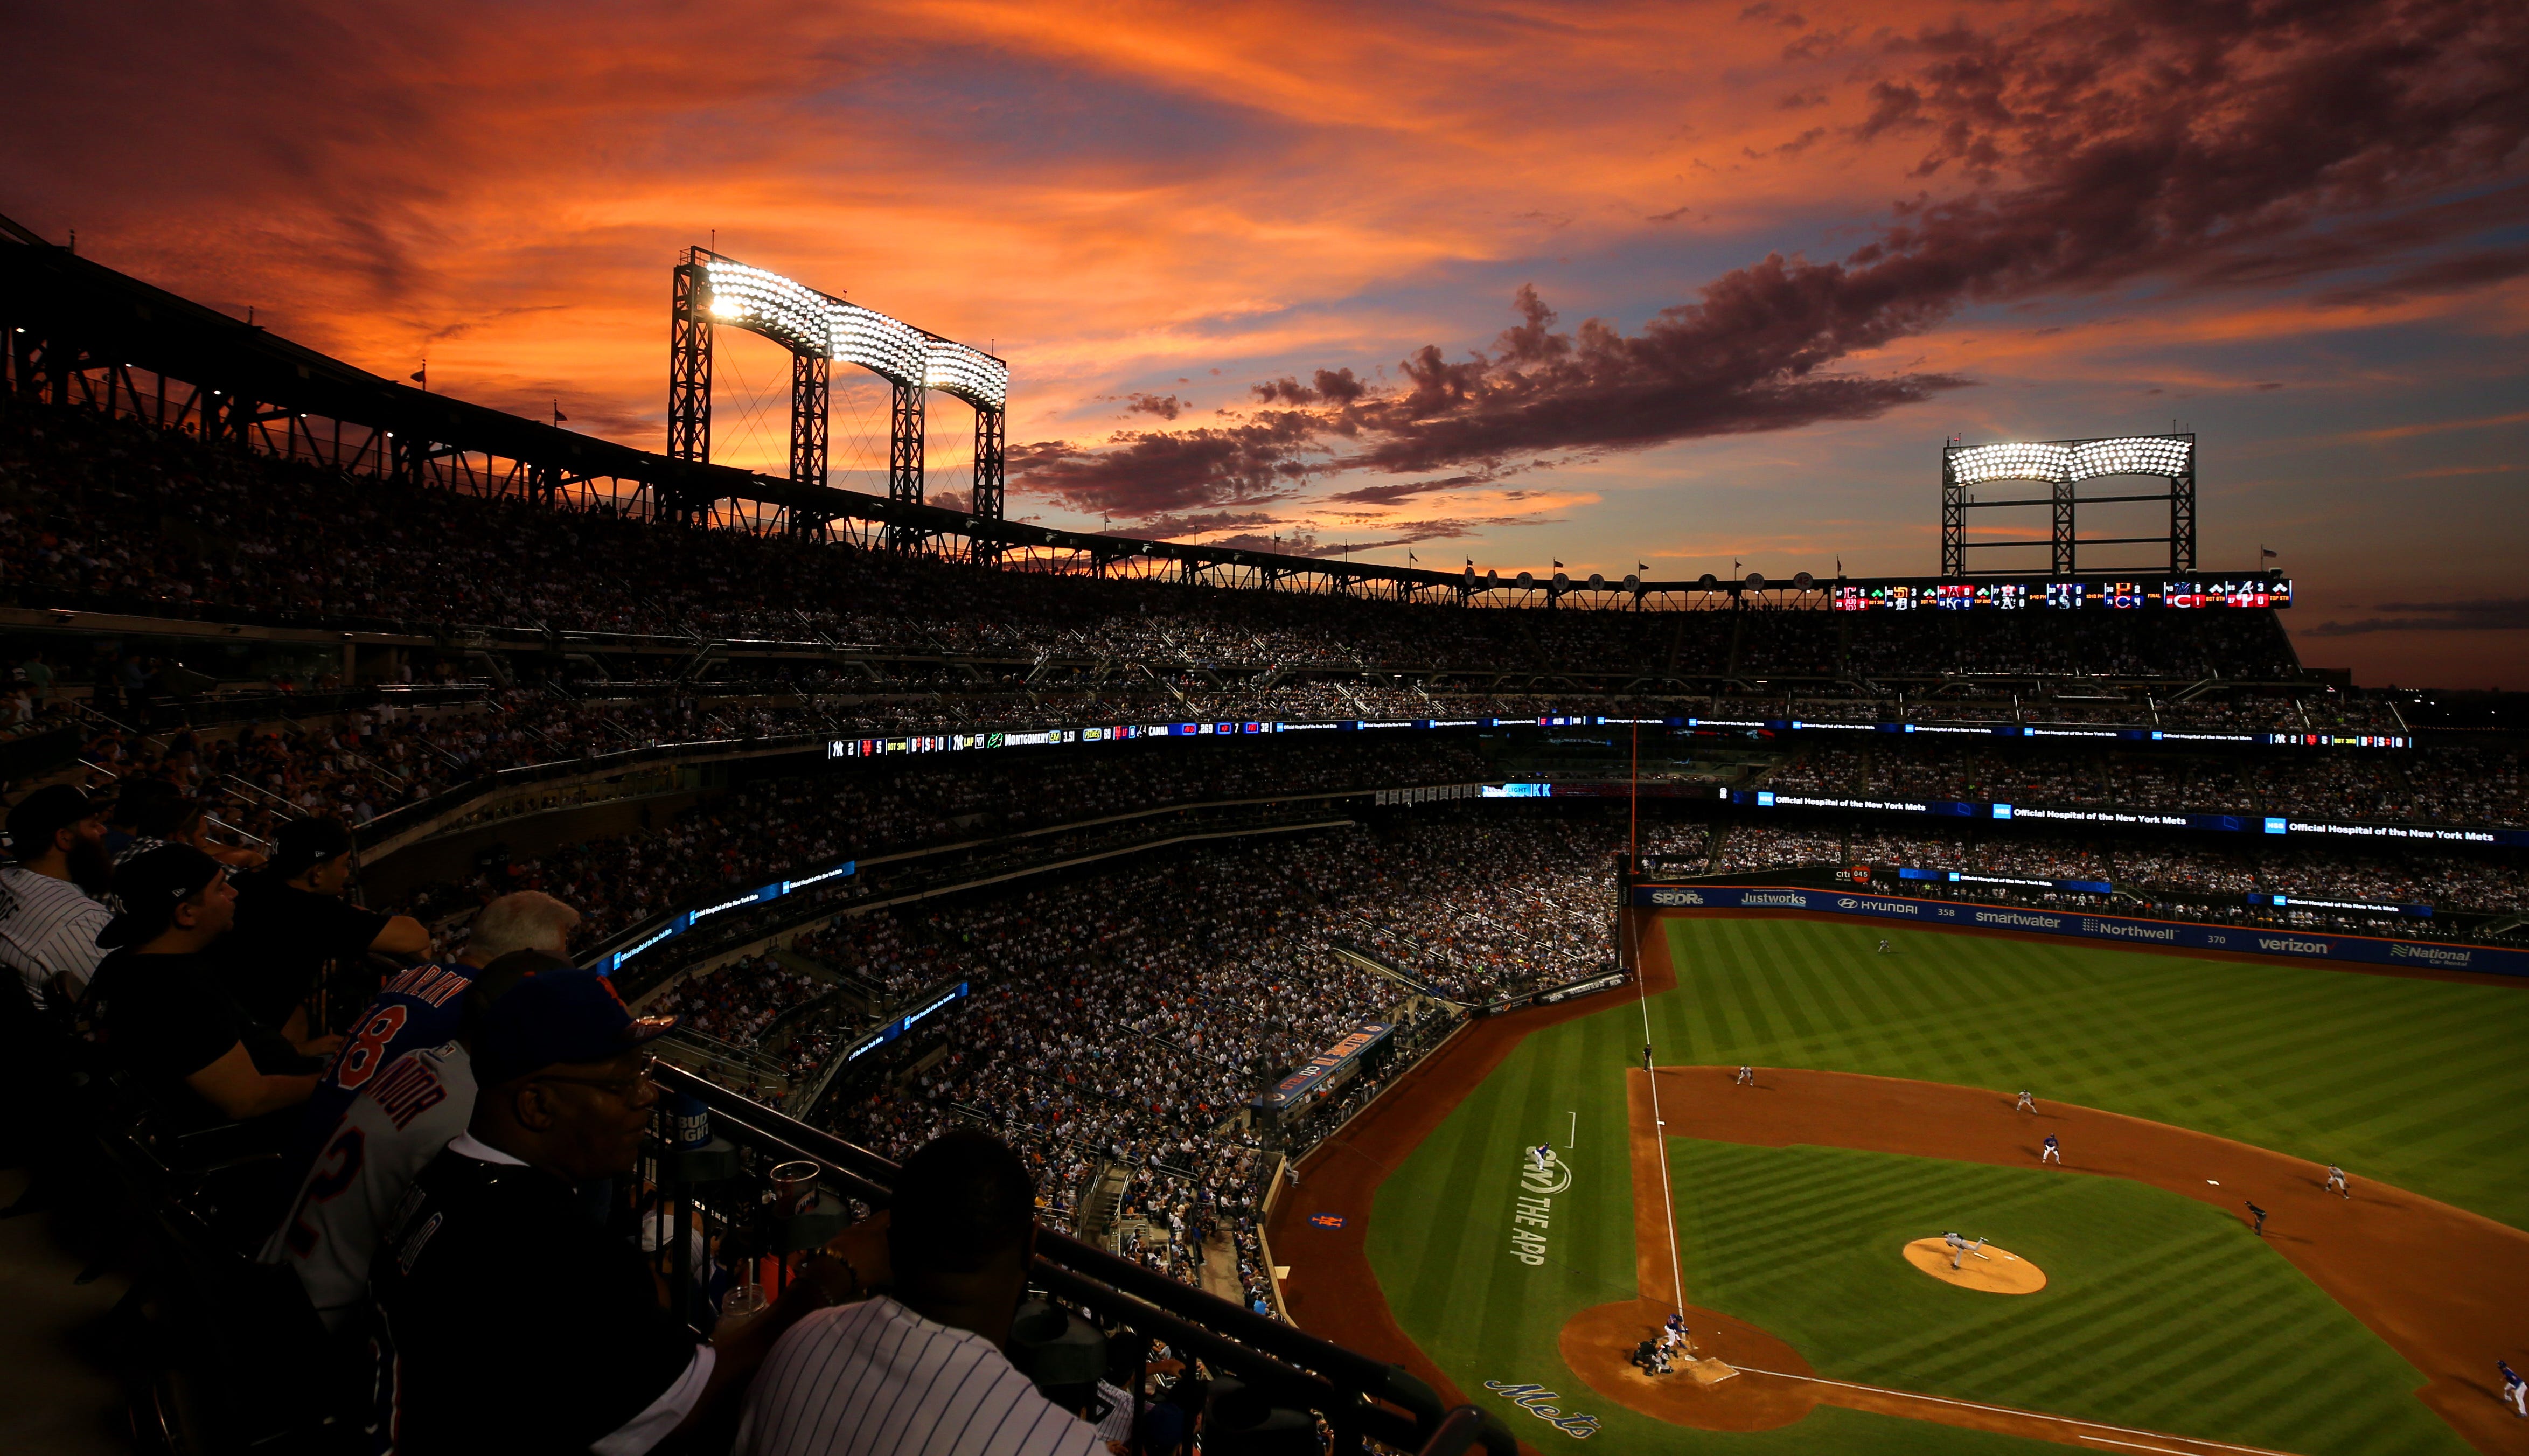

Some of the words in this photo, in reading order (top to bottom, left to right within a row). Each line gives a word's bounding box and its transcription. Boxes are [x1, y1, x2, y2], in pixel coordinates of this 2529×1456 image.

[1521, 576, 1529, 585] 31
[1557, 576, 1565, 586] 41
[1593, 577, 1600, 586] 14
[1627, 579, 1636, 587] 37
[1797, 577, 1809, 586] 42
[2019, 587, 2024, 595] 0
[2076, 586, 2081, 594] 0
[2134, 585, 2140, 593] 2
[2195, 584, 2201, 593] 2
[2258, 583, 2264, 591] 3
[2258, 596, 2264, 604] 0
[1148, 726, 1168, 736] CANHA
[1198, 724, 1213, 733] .269
[1235, 723, 1239, 733] 7
[1261, 723, 1269, 732] 32
[964, 737, 974, 747] LHP
[977, 737, 983, 746] 47
[1005, 733, 1049, 746] MONTGOMERY
[1063, 731, 1075, 742] 3.51
[1104, 729, 1111, 739] 69
[2290, 735, 2296, 743] 2
[2322, 736, 2327, 744] 5
[848, 742, 853, 755] 2
[876, 741, 882, 753] 5
[1532, 784, 1541, 797] K
[1542, 784, 1551, 797] K
[1805, 798, 1838, 806] Hospital
[2047, 811, 2084, 819] Hospital
[2289, 823, 2325, 832] Official
[2328, 825, 2372, 835] Hospital
[2409, 830, 2434, 838] New
[2435, 831, 2462, 839] York
[2464, 832, 2494, 841] Mets
[1741, 893, 1806, 907] Justworks
[1862, 901, 1918, 914] HYUNDAI
[1976, 912, 2060, 928] smartwater
[2100, 924, 2173, 939] Northwell
[2208, 936, 2225, 944] 370
[2259, 939, 2328, 954] verizon
[2408, 947, 2470, 961] National
[1323, 1033, 1375, 1057] WELCOME
[1311, 1057, 1341, 1067] TO
[1299, 1066, 1320, 1076] citi
[1279, 1074, 1309, 1090] FIELD
[362, 1056, 448, 1132] INDOR
[677, 1112, 708, 1129] BUD
[680, 1123, 709, 1142] IGHT
[1515, 1197, 1550, 1229] THE
[1510, 1228, 1546, 1266] APP
[1483, 1380, 1601, 1439] Mets
